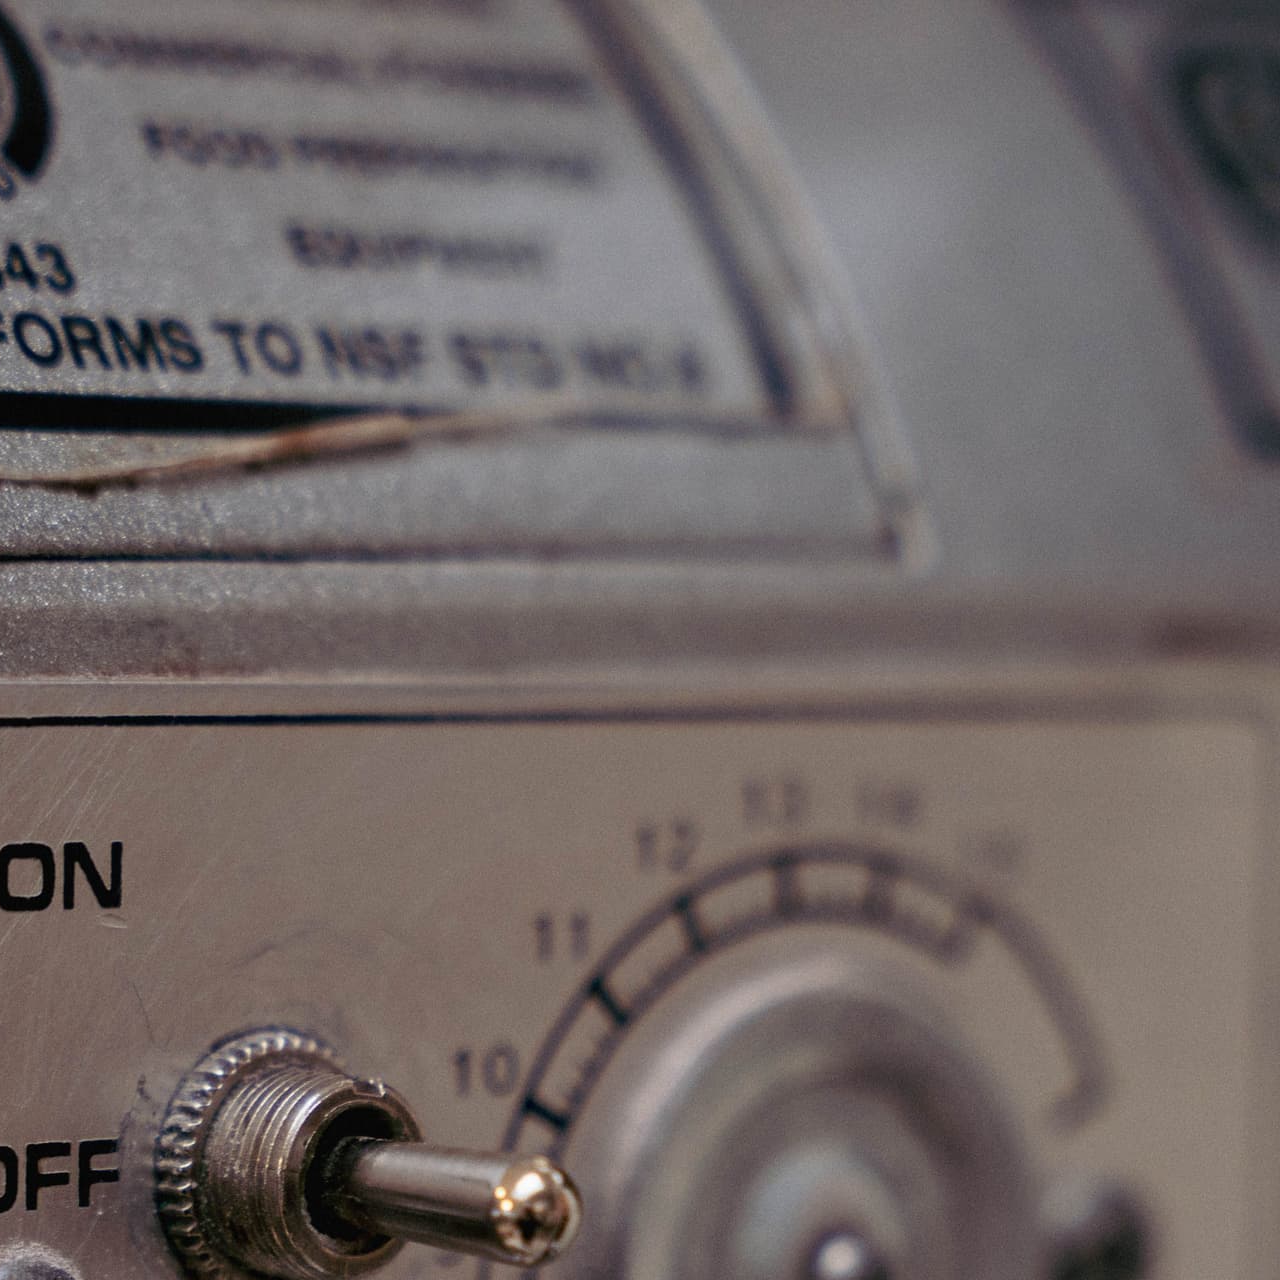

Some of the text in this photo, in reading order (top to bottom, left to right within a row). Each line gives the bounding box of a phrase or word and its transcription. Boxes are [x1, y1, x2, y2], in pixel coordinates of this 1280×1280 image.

[211, 321, 304, 377] TO
[321, 327, 427, 381] NSF
[636, 820, 699, 873] 12
[532, 912, 590, 962] 11
[452, 1046, 521, 1098] 10
